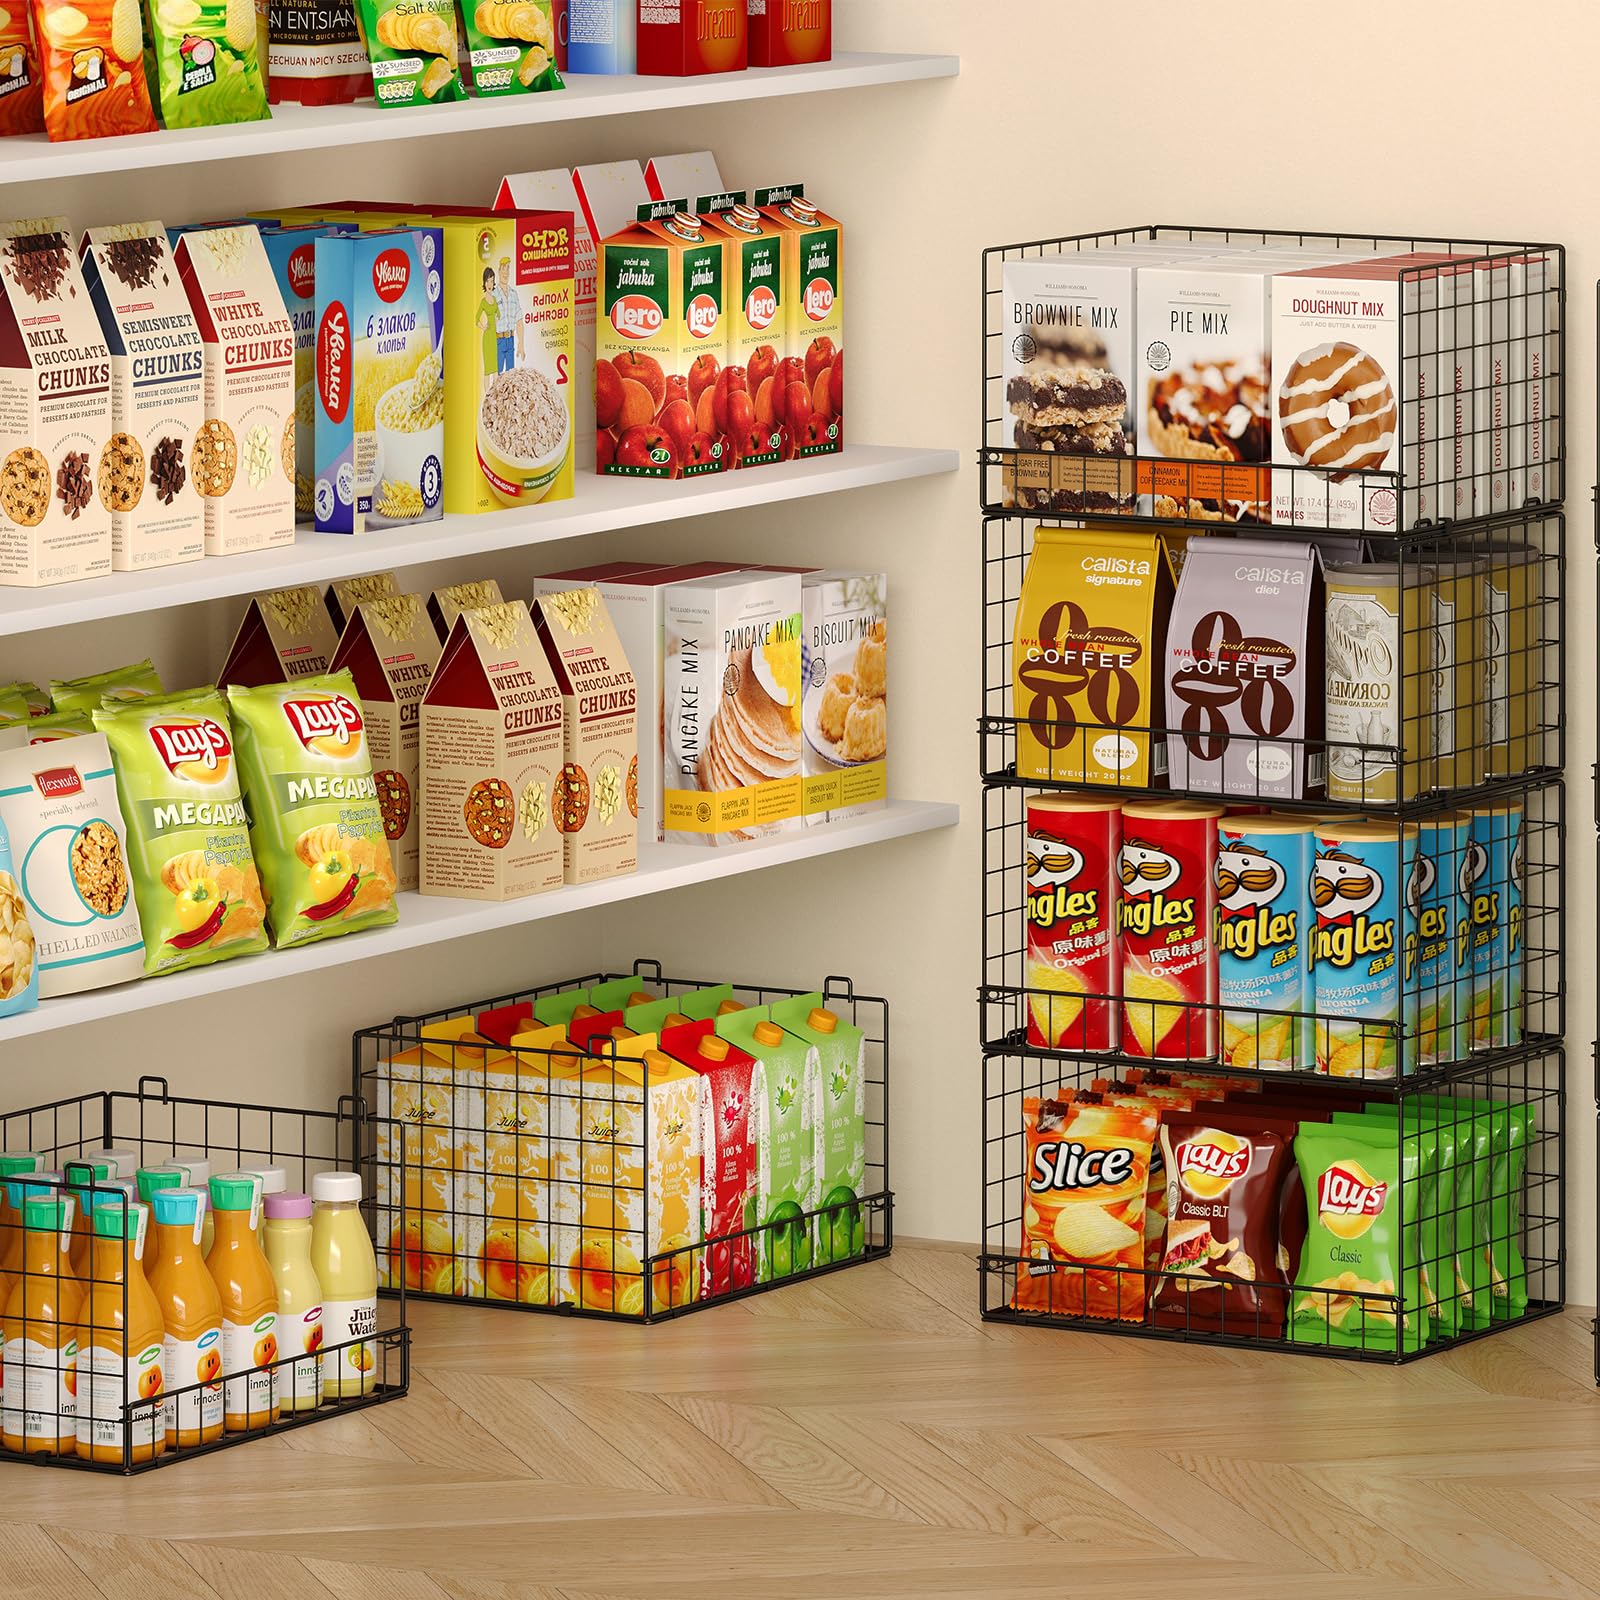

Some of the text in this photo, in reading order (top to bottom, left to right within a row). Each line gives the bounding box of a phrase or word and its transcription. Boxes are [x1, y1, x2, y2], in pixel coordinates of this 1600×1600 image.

[395, 0, 425, 17] Salt
[272, 32, 309, 41] MICROWAVE
[337, 31, 346, 39] TO
[66, 78, 108, 101] ORIGINAL
[375, 260, 407, 287] Увелка
[749, 259, 773, 283] jabuka
[807, 253, 831, 275] jabuka
[616, 268, 656, 290] jabuka
[690, 271, 714, 292] jabuka
[748, 294, 776, 322] Lero
[805, 286, 833, 316] Lero
[1292, 298, 1385, 318] DOUGHNUT MIX
[213, 302, 264, 322] WHITE
[615, 301, 662, 330] Lero
[690, 302, 717, 335] Lero
[1013, 302, 1119, 329] BROWNIE MIX
[122, 313, 193, 335] SEMISWEET
[220, 319, 291, 341] CHOCOLATE
[367, 311, 416, 338] 6 злаков
[1170, 311, 1229, 336] PIE MIX
[1328, 322, 1350, 330] BUTTER
[1357, 323, 1377, 331] WATER
[26, 328, 69, 348] MILK
[128, 331, 201, 353] CHOCOLATE
[376, 336, 406, 354] хлопья
[34, 344, 108, 366] CHOCOLATE
[225, 338, 293, 366] CHUNKS
[618, 344, 671, 354] KONZERVANSA
[132, 350, 203, 379] CHUNKS
[327, 311, 346, 410] Увелка
[38, 363, 110, 392] CHUNKS
[40, 397, 108, 414] PREMIUM CHOCOLATE FOR
[42, 408, 107, 424] DESSERTS AND PASTRIES
[746, 453, 778, 463] NEKTAR
[804, 443, 836, 454] NEKTAR
[610, 466, 663, 475] NEKTAR
[687, 463, 720, 474] NEKTAR
[428, 471, 435, 492] 3
[1275, 495, 1291, 506] NET
[1307, 498, 1321, 508] 17.4
[1336, 500, 1358, 512] (493g)
[1085, 574, 1143, 587] signature
[1255, 584, 1281, 596] diet
[724, 618, 795, 653] PANCAKE MIX
[813, 615, 878, 648] BISCUIT MIX
[1053, 628, 1144, 645] fresh roasted
[1206, 639, 1297, 655] fresh roasted
[285, 655, 329, 676] WHITE
[567, 656, 610, 677] WHITE
[1026, 647, 1134, 669] COFFEE
[1179, 658, 1287, 679] COFFEE
[388, 663, 432, 684] WHITE
[491, 670, 536, 691] WHITE
[575, 671, 634, 693] CHOCOLATE
[500, 686, 560, 708] CHOCOLATE
[579, 688, 636, 715] CHUNKS
[682, 638, 698, 776] PANCAKE MIX
[504, 702, 562, 730] CHUNKS
[505, 732, 561, 749] PREMIUM CHOCOLATE FOR
[507, 747, 530, 758] DESSERTS
[540, 742, 559, 754] PASTRIES
[38, 773, 80, 795] flexnuts
[1103, 772, 1116, 780] 20
[39, 805, 73, 820] specially
[1068, 916, 1100, 937] 品客
[1165, 924, 1197, 945] 品客
[38, 923, 139, 958] HELLED WALNUTS
[1053, 928, 1112, 956] 原味薯
[1150, 936, 1208, 964] 原味薯
[1054, 950, 1101, 970] Original
[1271, 944, 1298, 968] 品客
[1368, 953, 1396, 977] 品客
[1151, 957, 1198, 978] Original
[405, 1107, 436, 1120] Juice
[497, 1116, 528, 1129] Juice
[588, 1125, 620, 1138] Juice
[722, 1147, 735, 1158] 100
[589, 1164, 609, 1175] 100
[1030, 1142, 1134, 1192] Slice
[1182, 1202, 1230, 1218] Classic BLT
[1329, 1245, 1362, 1264] Classic
[350, 1307, 377, 1323] Juic
[348, 1322, 377, 1336] Wate
[193, 1391, 222, 1406] innocen
